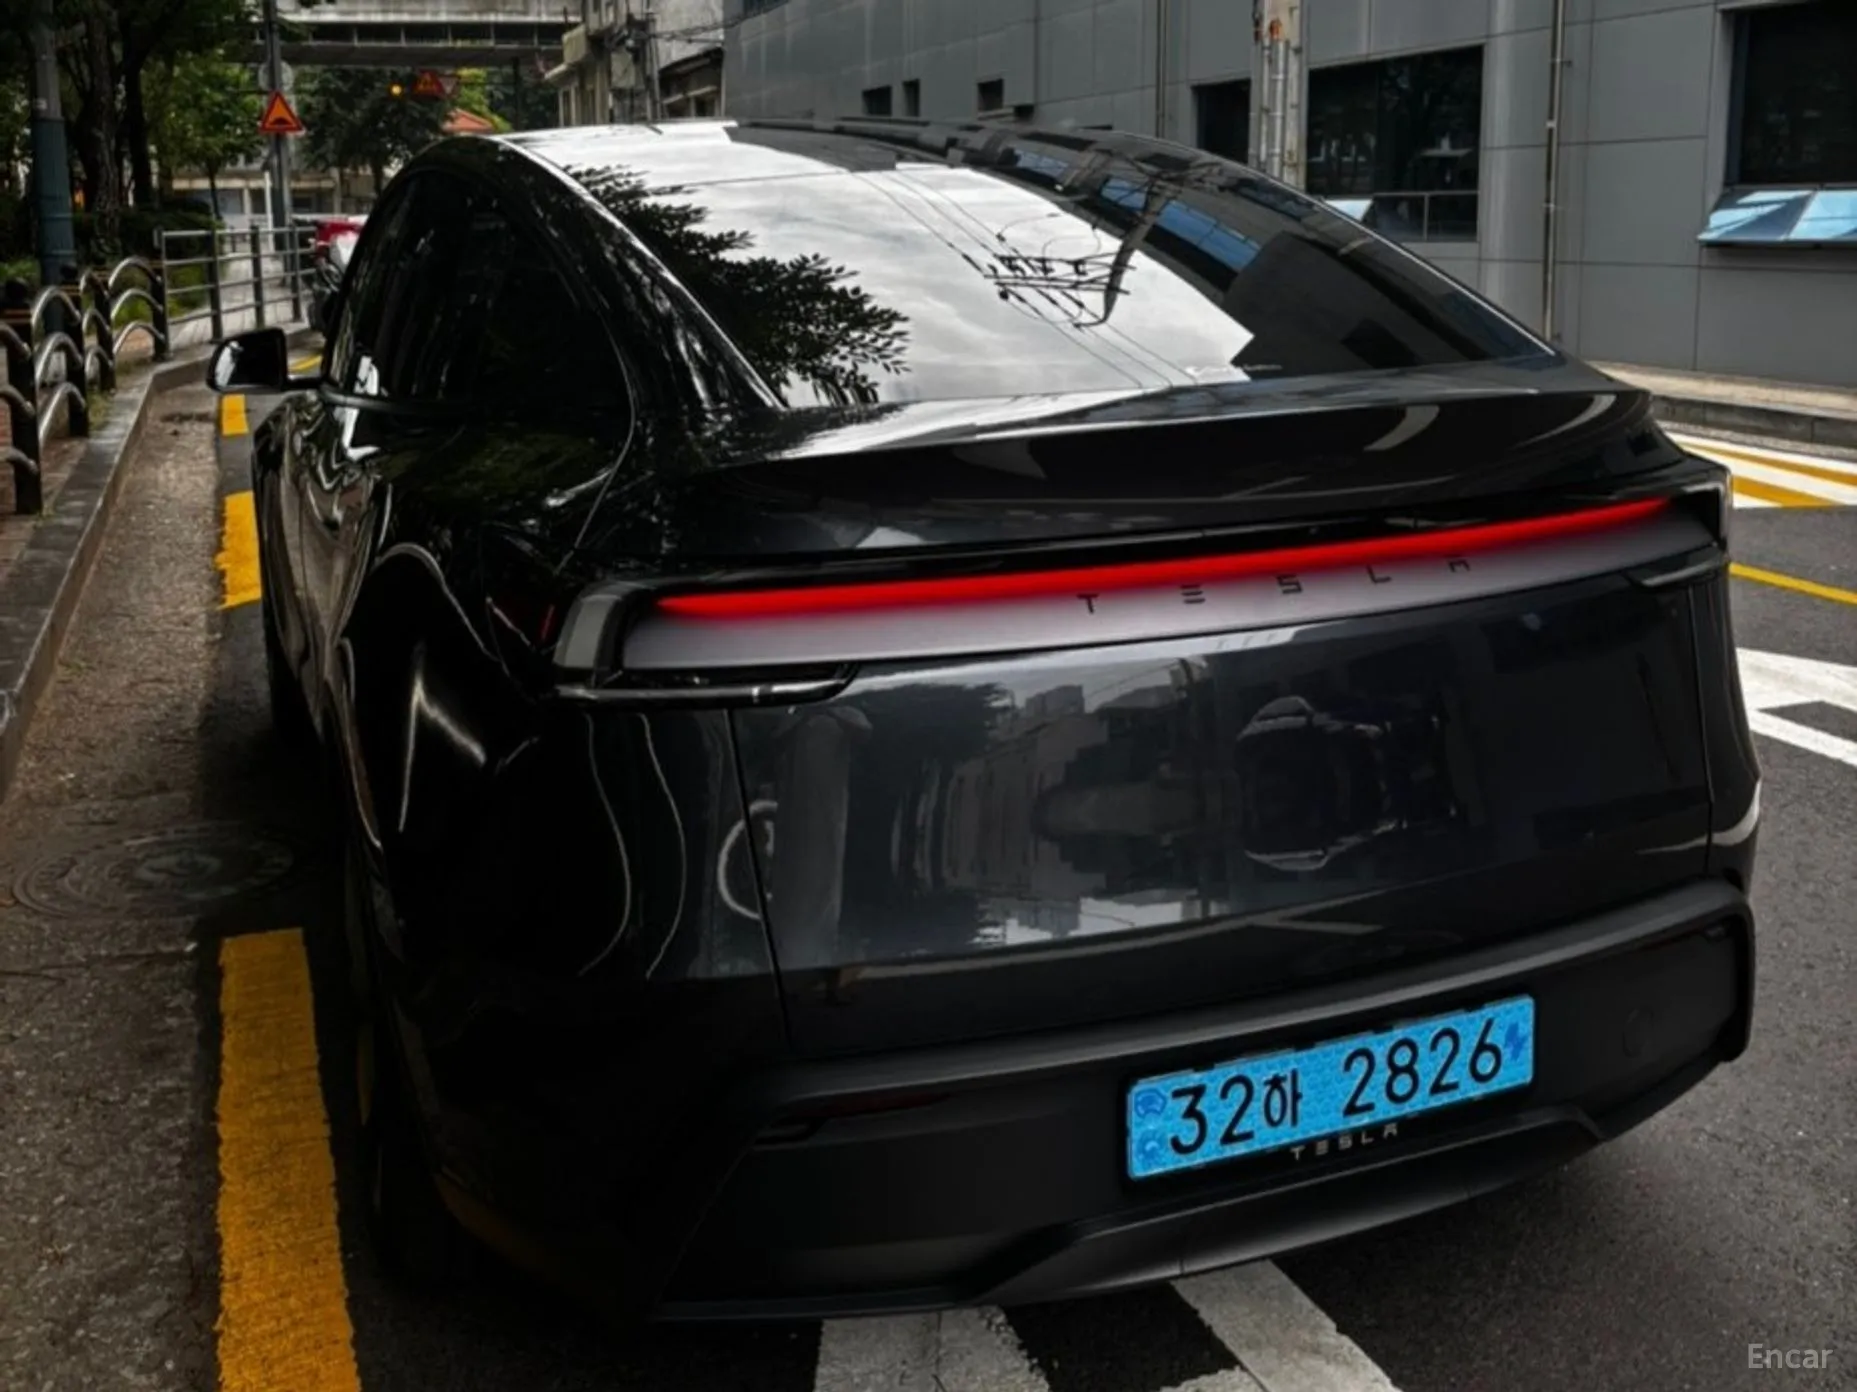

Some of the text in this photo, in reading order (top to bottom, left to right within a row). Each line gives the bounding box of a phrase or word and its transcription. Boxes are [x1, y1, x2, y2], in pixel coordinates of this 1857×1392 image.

[1077, 554, 1470, 614] TESLA
[1169, 1017, 1502, 1155] 32하 2826
[1290, 1123, 1398, 1160] TESLA
